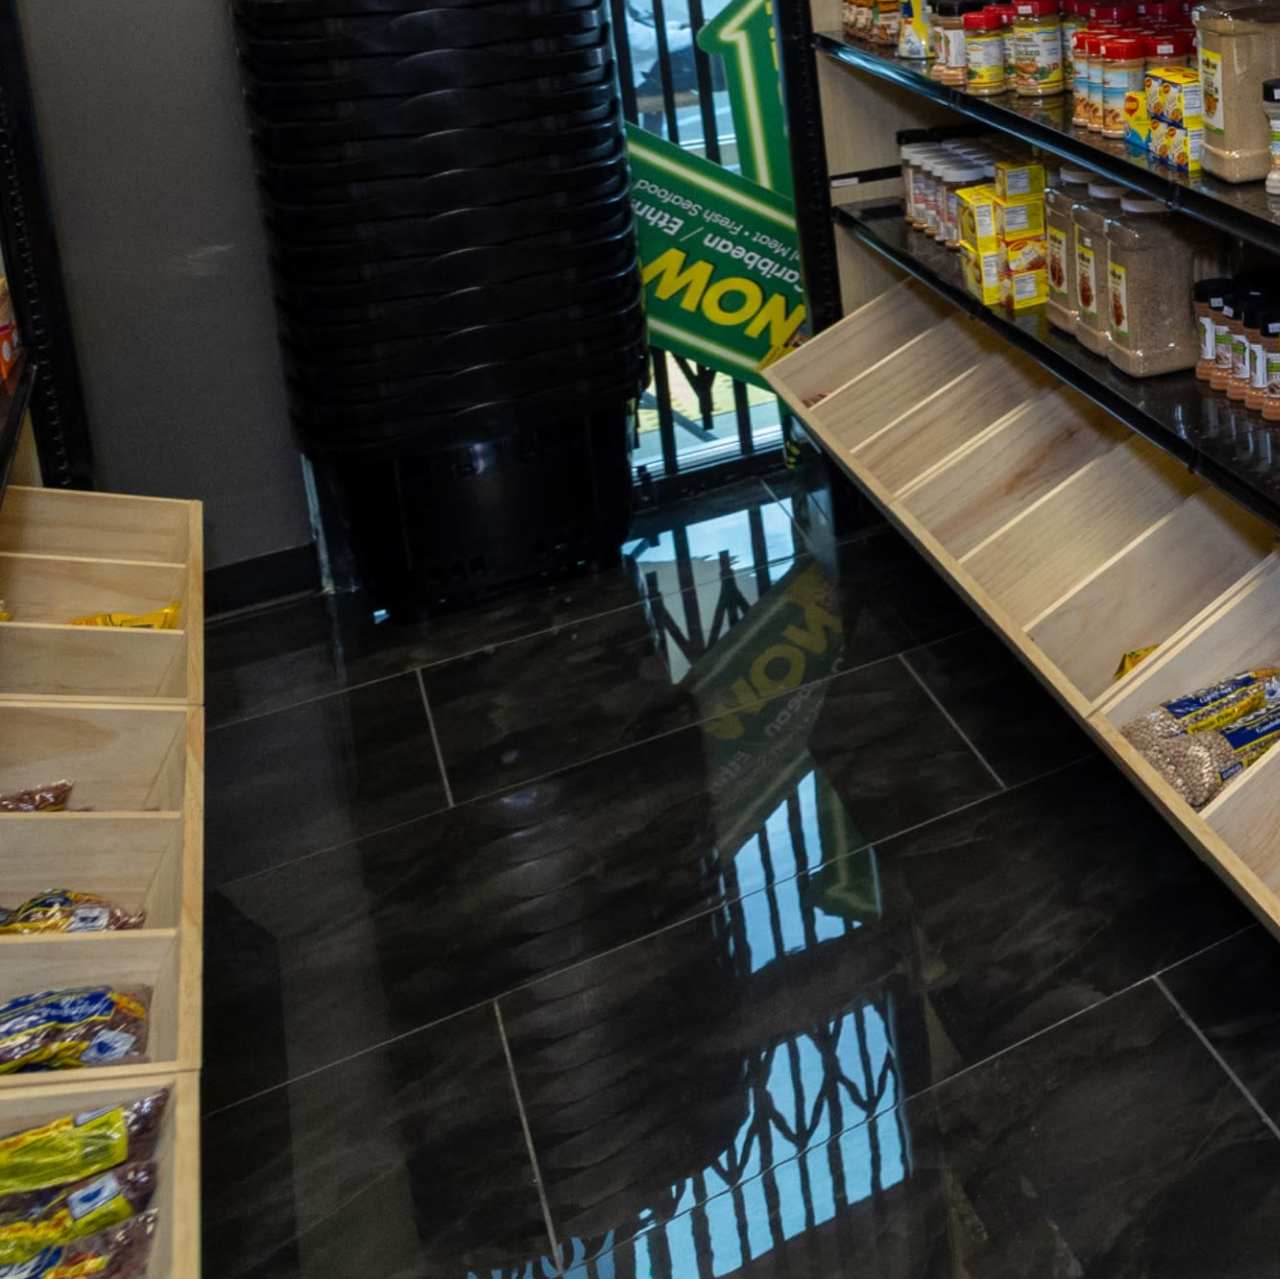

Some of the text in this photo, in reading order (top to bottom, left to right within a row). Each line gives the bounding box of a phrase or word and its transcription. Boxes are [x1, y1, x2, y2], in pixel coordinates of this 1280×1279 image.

[630, 199, 685, 237] Ethn
[633, 179, 743, 235] Fresh Seafood
[752, 231, 790, 256] Meat
[640, 247, 807, 349] NOW
